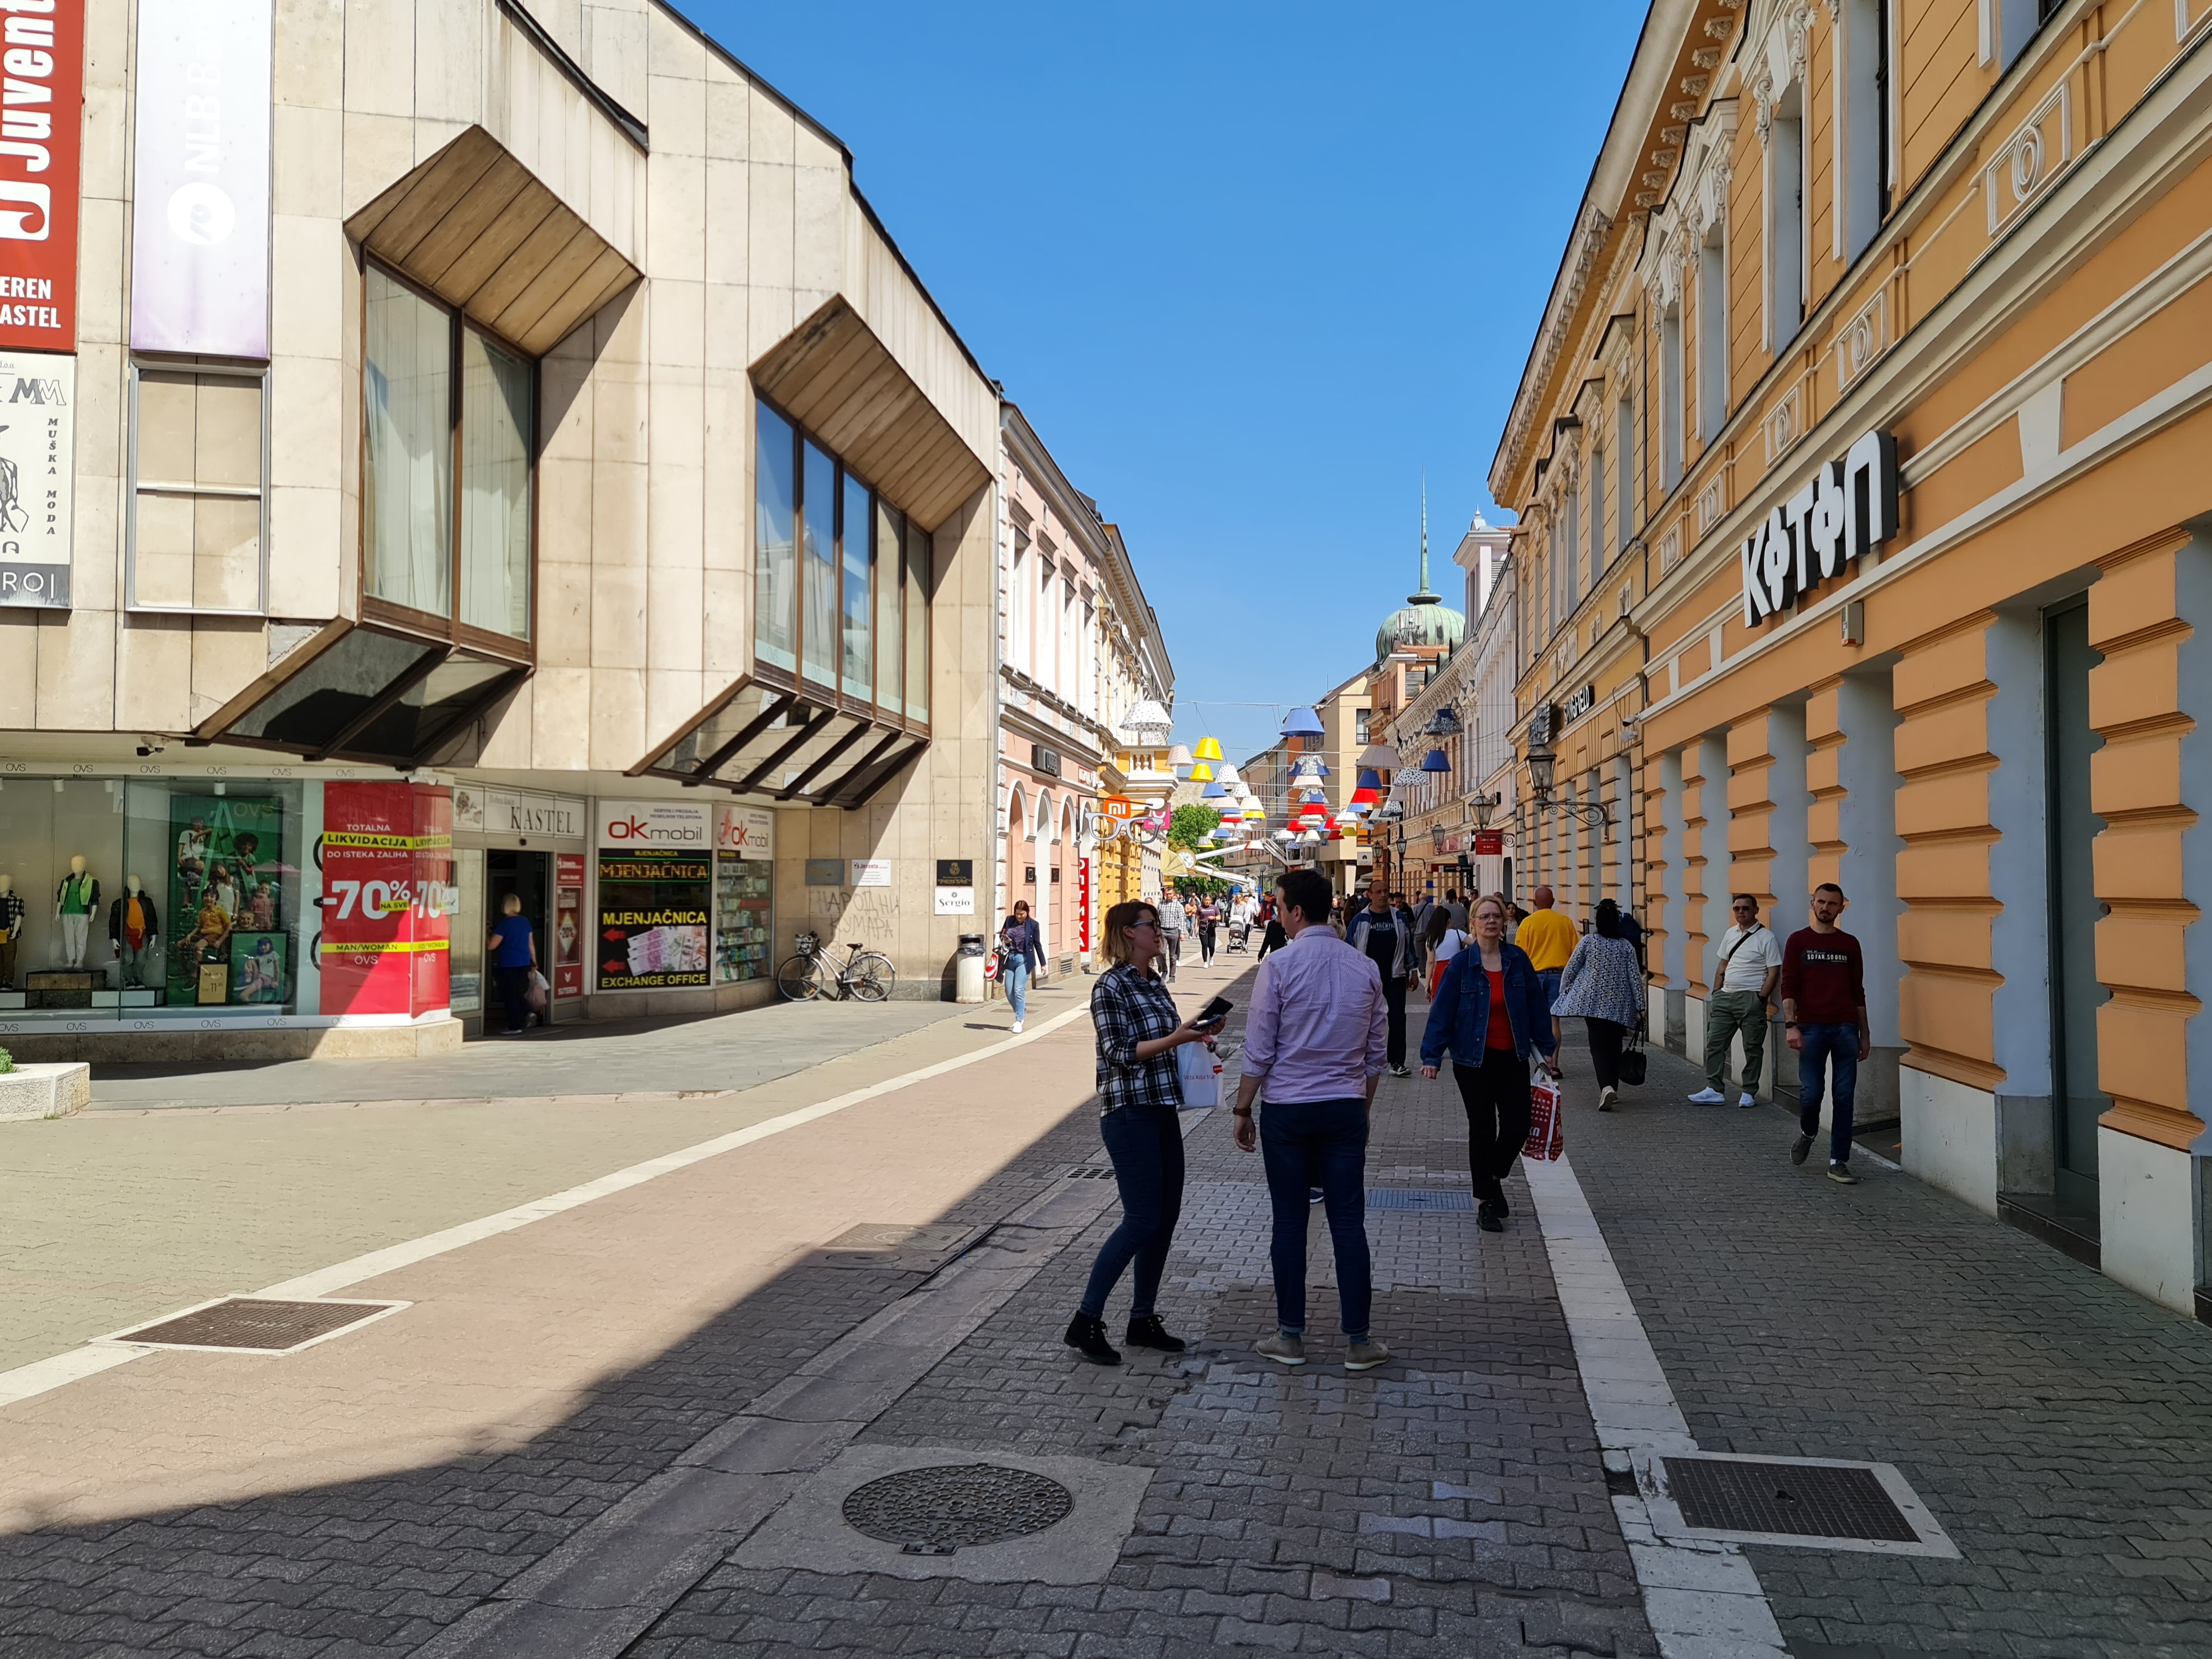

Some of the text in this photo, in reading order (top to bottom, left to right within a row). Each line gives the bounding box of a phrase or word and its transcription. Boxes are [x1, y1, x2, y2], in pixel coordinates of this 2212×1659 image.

[185, 95, 221, 174] NLB
[0, 276, 51, 300] EREN
[0, 304, 62, 328] ASTEL
[5, 763, 26, 772] OVS
[73, 764, 93, 773] OVS
[140, 765, 160, 774] OVS
[207, 766, 227, 775] OVS
[272, 768, 291, 776] OVS
[510, 806, 575, 834] KASTEL
[347, 823, 390, 832] TOTALNA
[327, 833, 408, 848] LIKVIDACIJA
[599, 861, 708, 878] MJENJAČNICA
[393, 901, 408, 909] SVE
[940, 899, 970, 907] Sergio
[603, 909, 707, 925] MJENJAČNICA
[336, 943, 398, 952] MAN/WOMAN
[354, 954, 378, 965] OVS
[424, 953, 436, 963] OVS
[601, 974, 707, 988] EXCHANGE OFFICE
[0, 1023, 19, 1032] OVS
[66, 1022, 87, 1031] OVS
[134, 1021, 154, 1030] OVS
[201, 1019, 221, 1028] OVS
[267, 1018, 287, 1026] OVS
